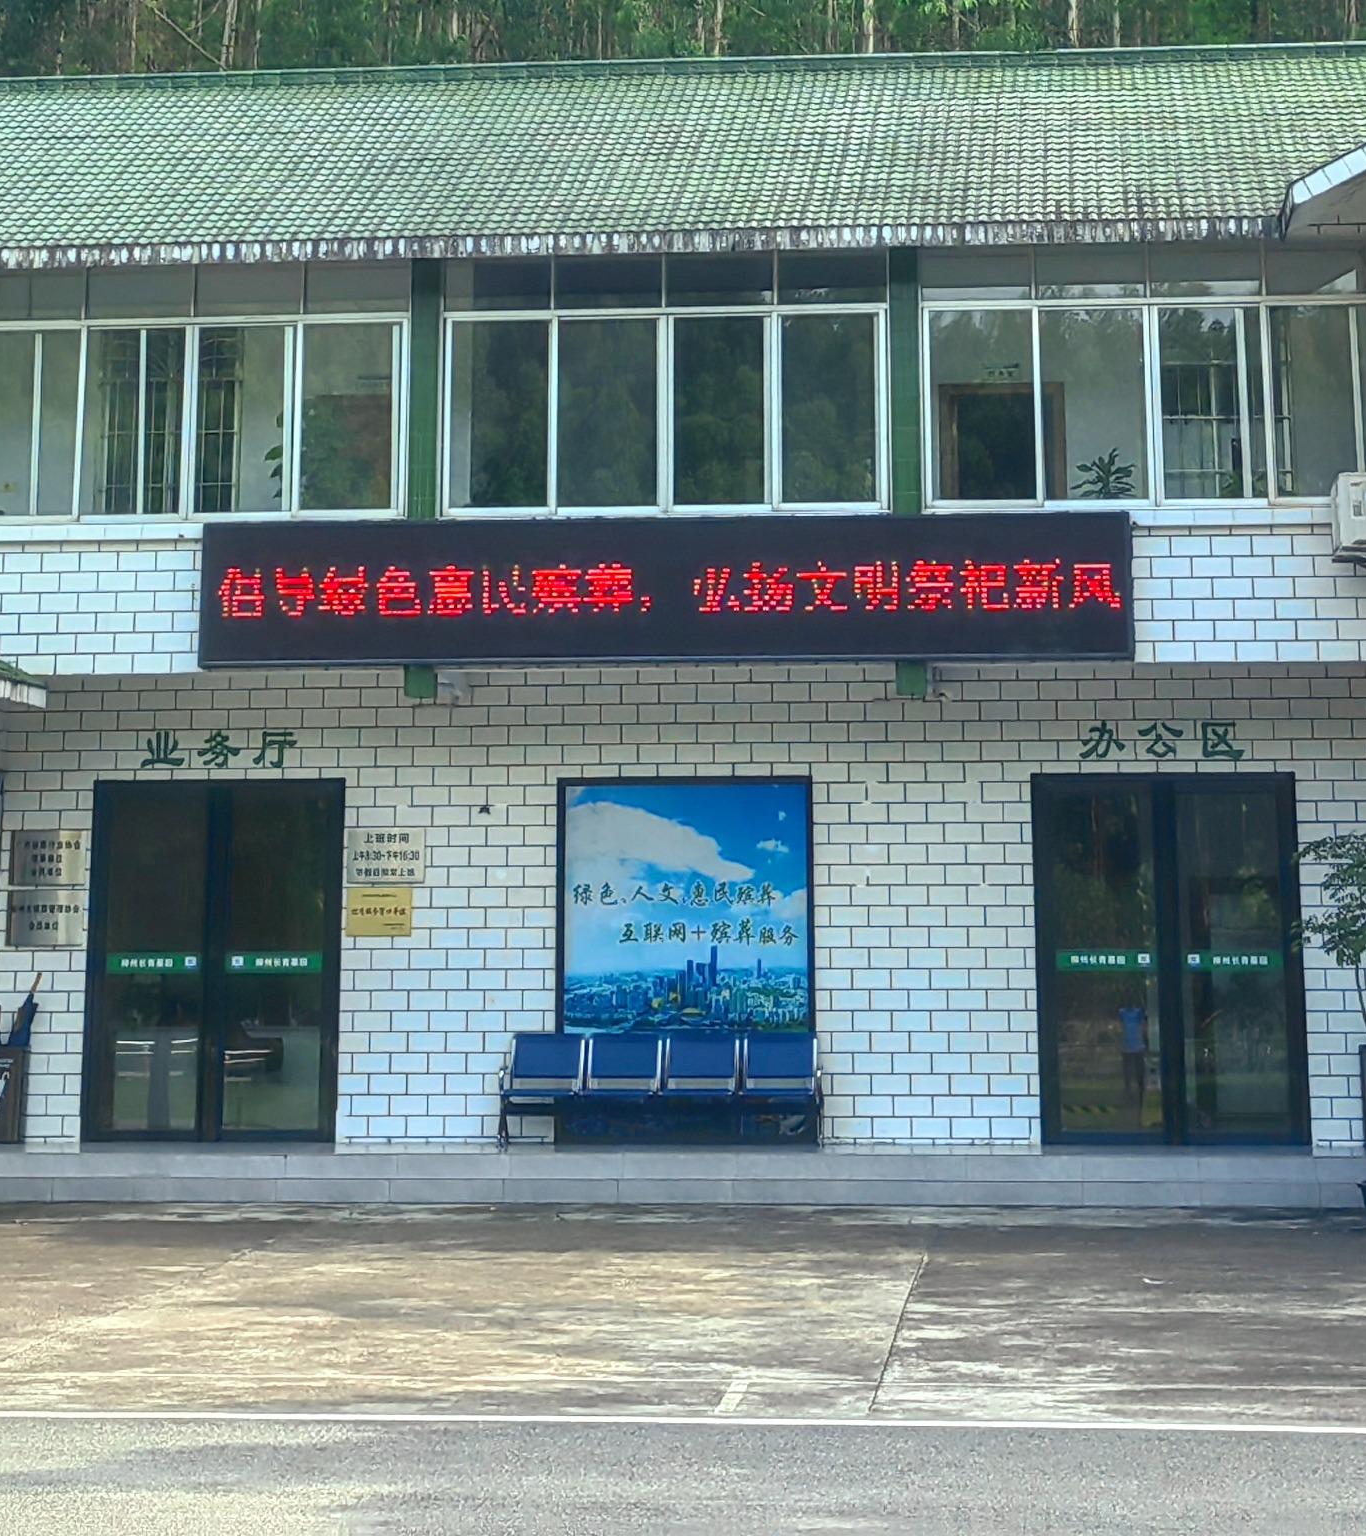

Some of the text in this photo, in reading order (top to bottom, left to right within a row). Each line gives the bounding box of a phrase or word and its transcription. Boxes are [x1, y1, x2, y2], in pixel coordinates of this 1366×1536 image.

[140, 729, 298, 768] 业务厅
[1079, 719, 1245, 760] 办公区
[363, 832, 410, 844] 上班时间
[618, 917, 800, 947] 互联网+殡葬服务
